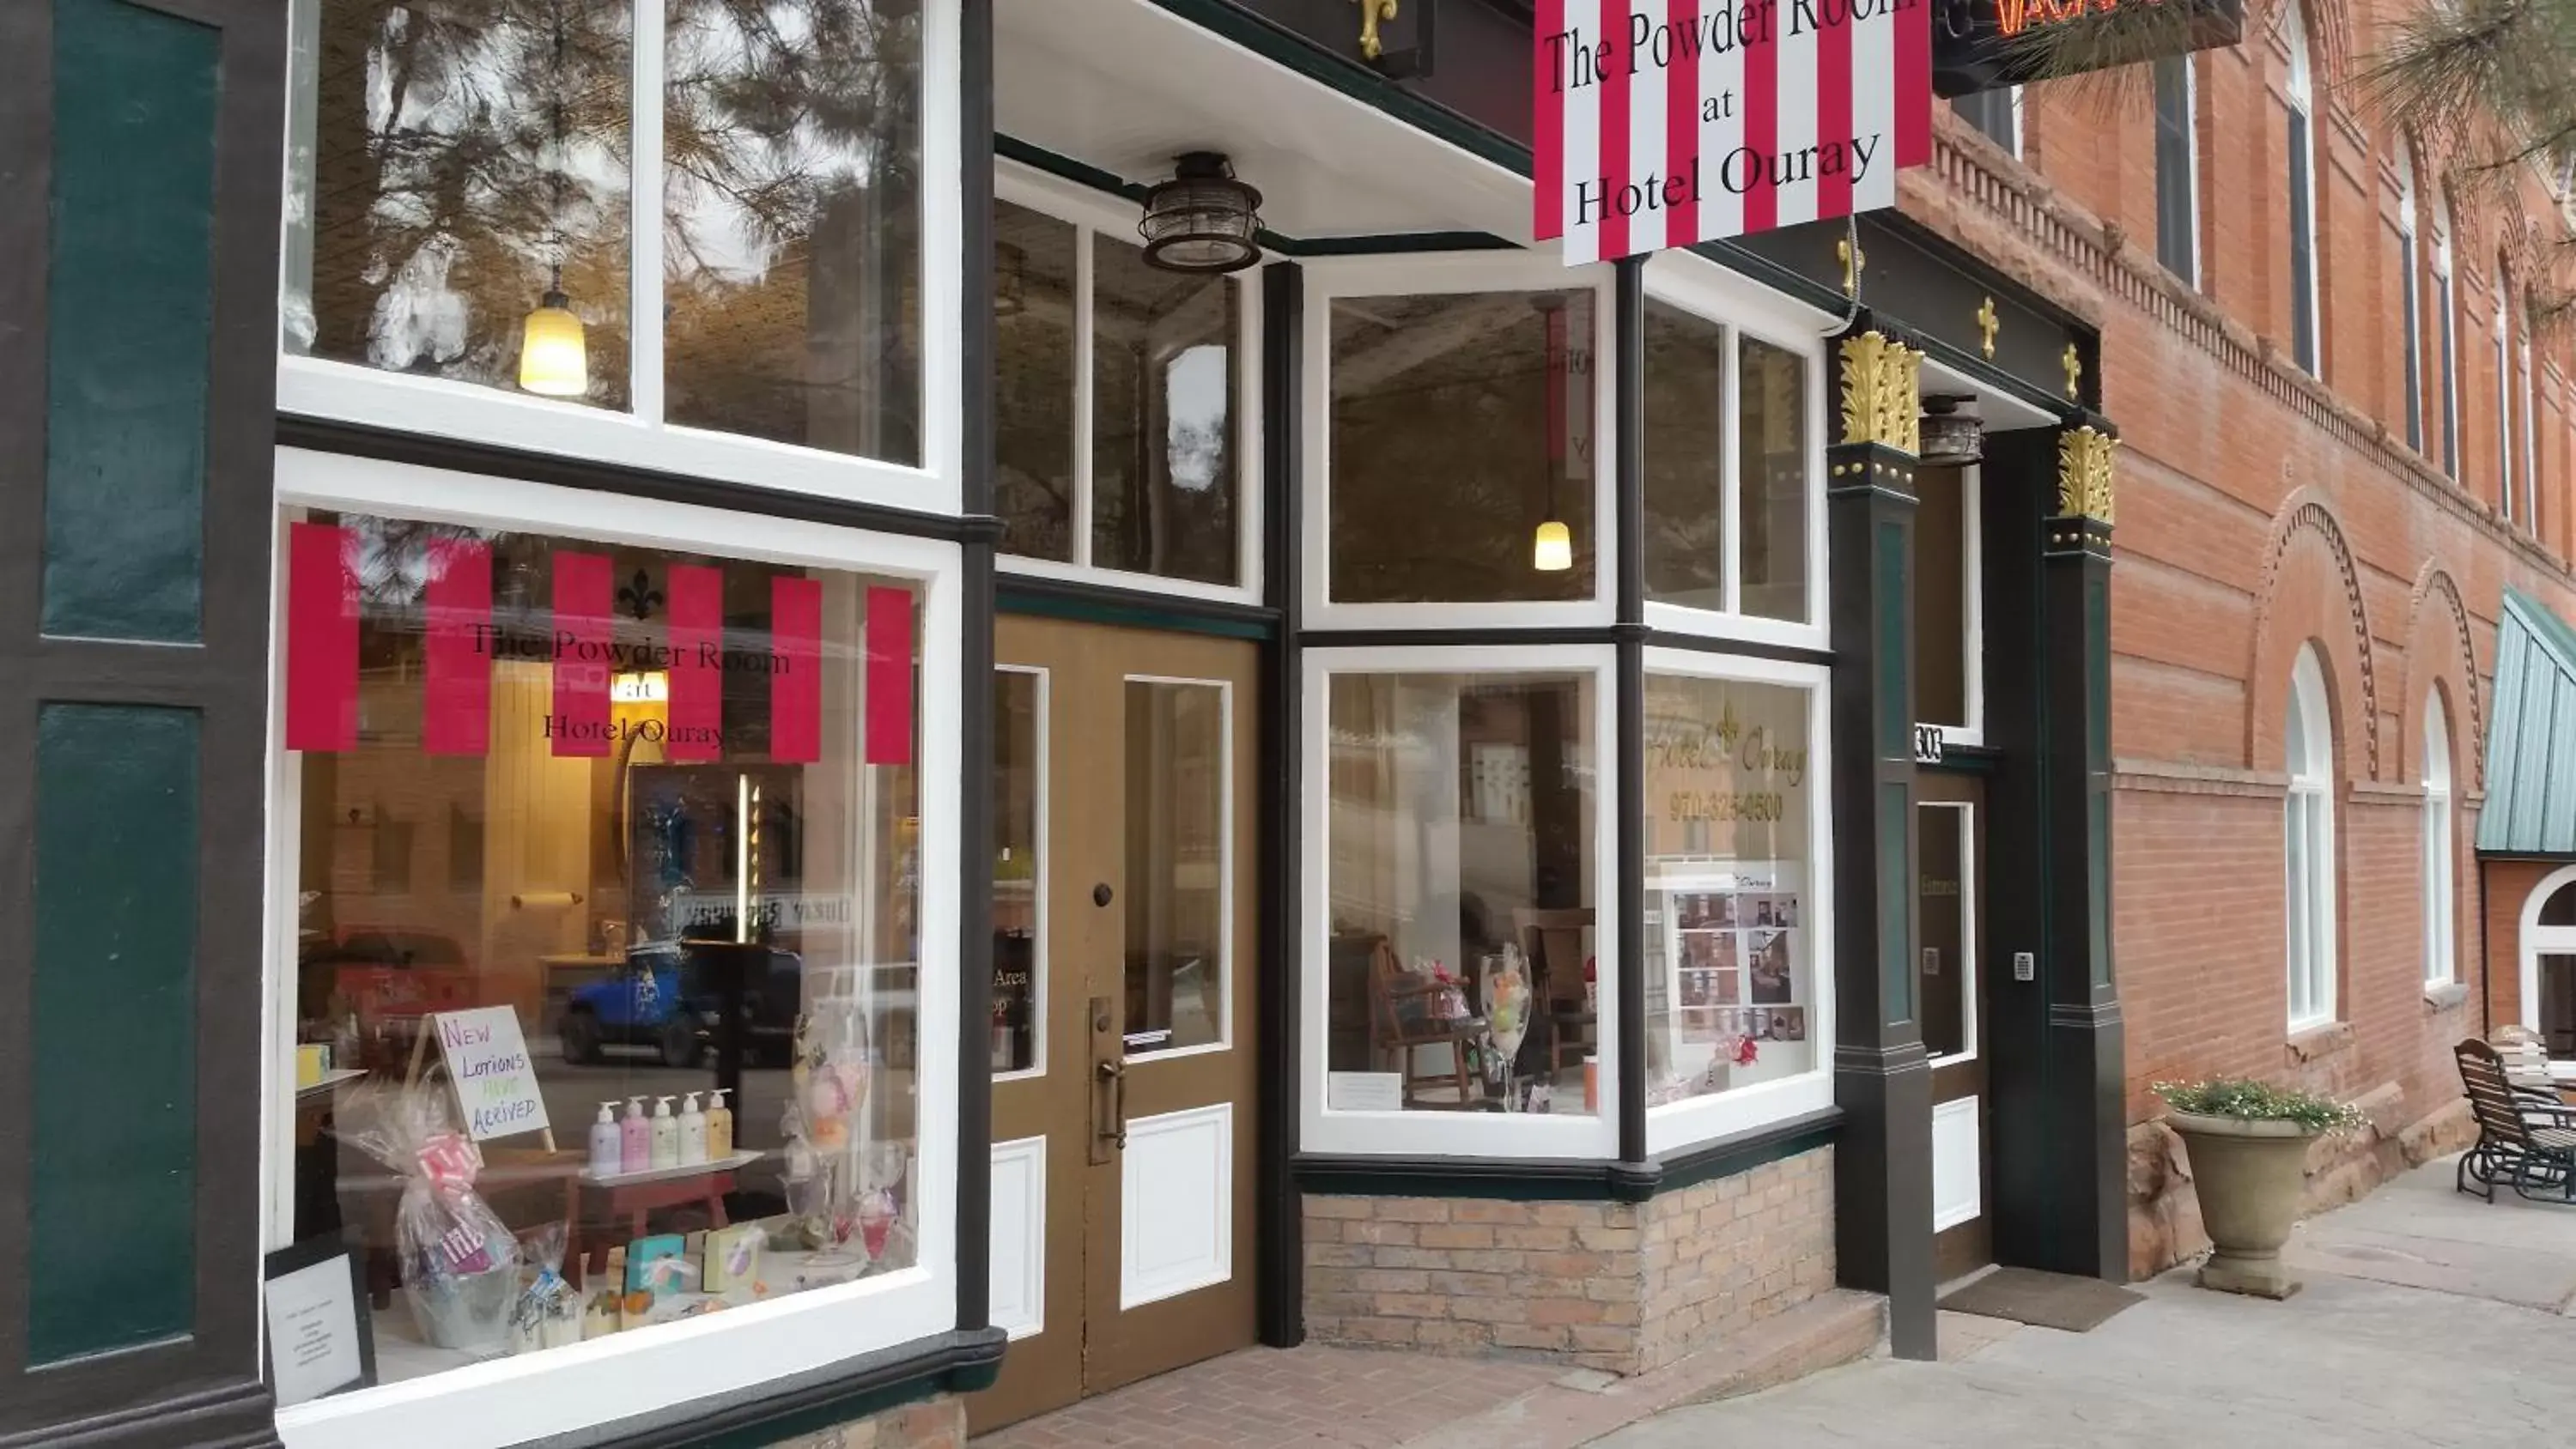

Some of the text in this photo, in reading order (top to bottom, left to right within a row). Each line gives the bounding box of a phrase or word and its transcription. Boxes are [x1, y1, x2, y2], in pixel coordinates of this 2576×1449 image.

[1544, 27, 1613, 94] The
[1627, 0, 1777, 75] Powder
[1702, 88, 1734, 123] at
[1574, 133, 1881, 225] Hotel Ouray
[466, 623, 790, 675] The Powder Room
[542, 714, 726, 750] Hotel Ouray
[1916, 725, 1942, 759] 303
[442, 1019, 492, 1049] NEW
